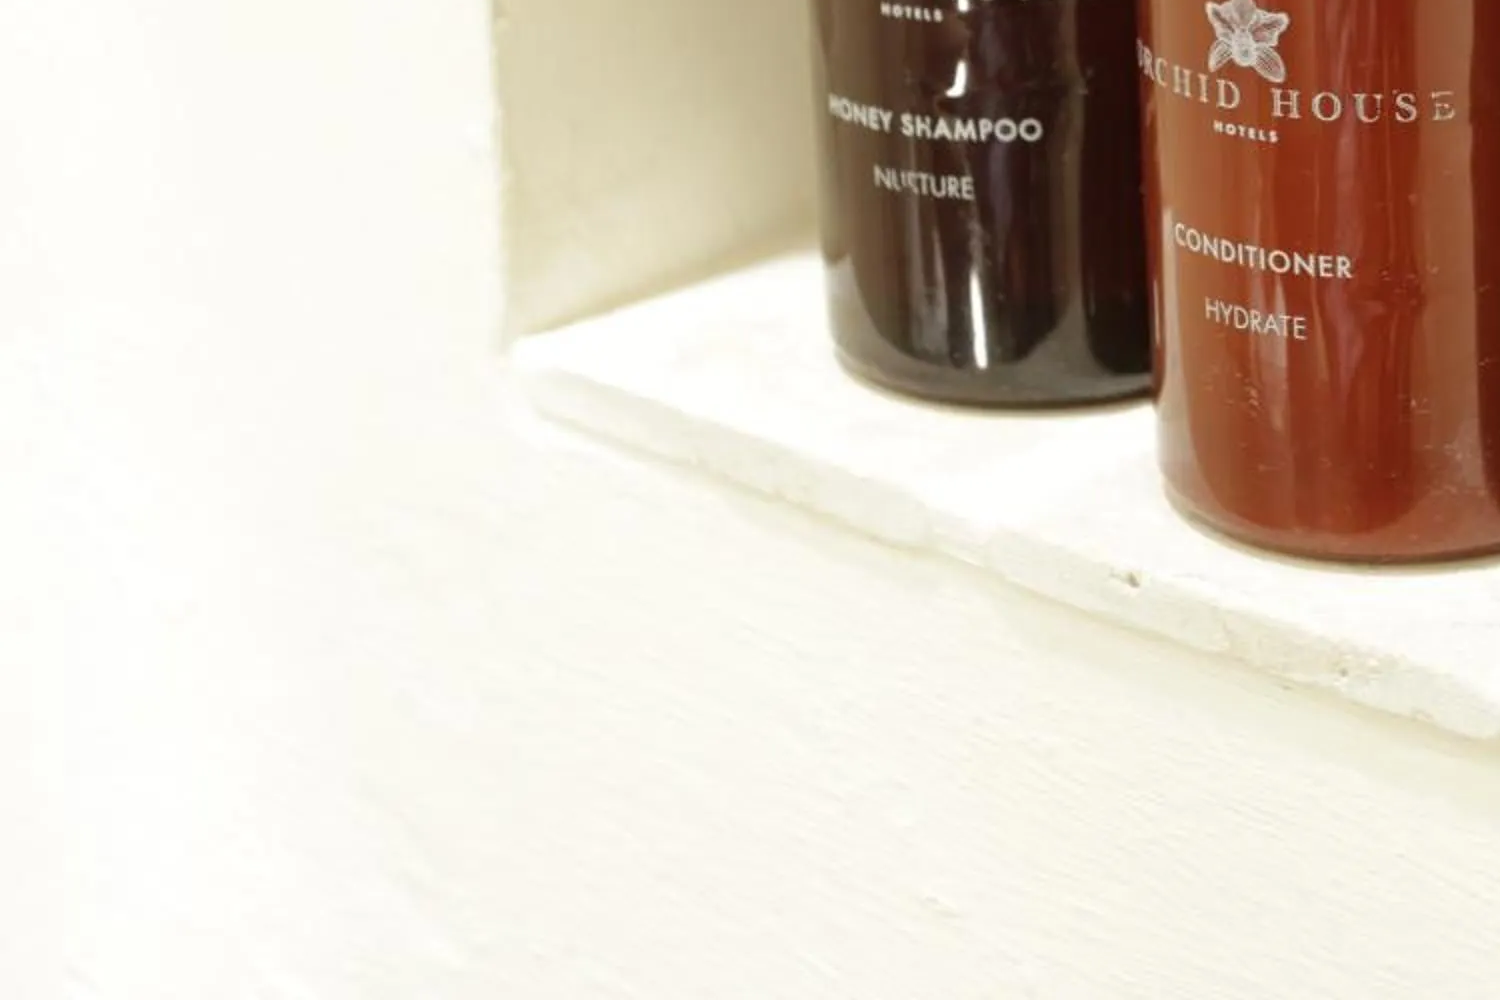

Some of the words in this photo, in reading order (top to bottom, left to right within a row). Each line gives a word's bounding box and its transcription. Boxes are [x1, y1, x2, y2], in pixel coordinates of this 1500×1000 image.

[881, 2, 944, 22] HOTELS
[828, 93, 894, 134] HONEY
[900, 113, 1043, 142] SHAMPOO
[1270, 86, 1456, 123] HOUSE
[1213, 120, 1279, 144] HOTELS
[1175, 222, 1353, 279] CONDITIONER
[1205, 297, 1308, 341] HYDRATE
